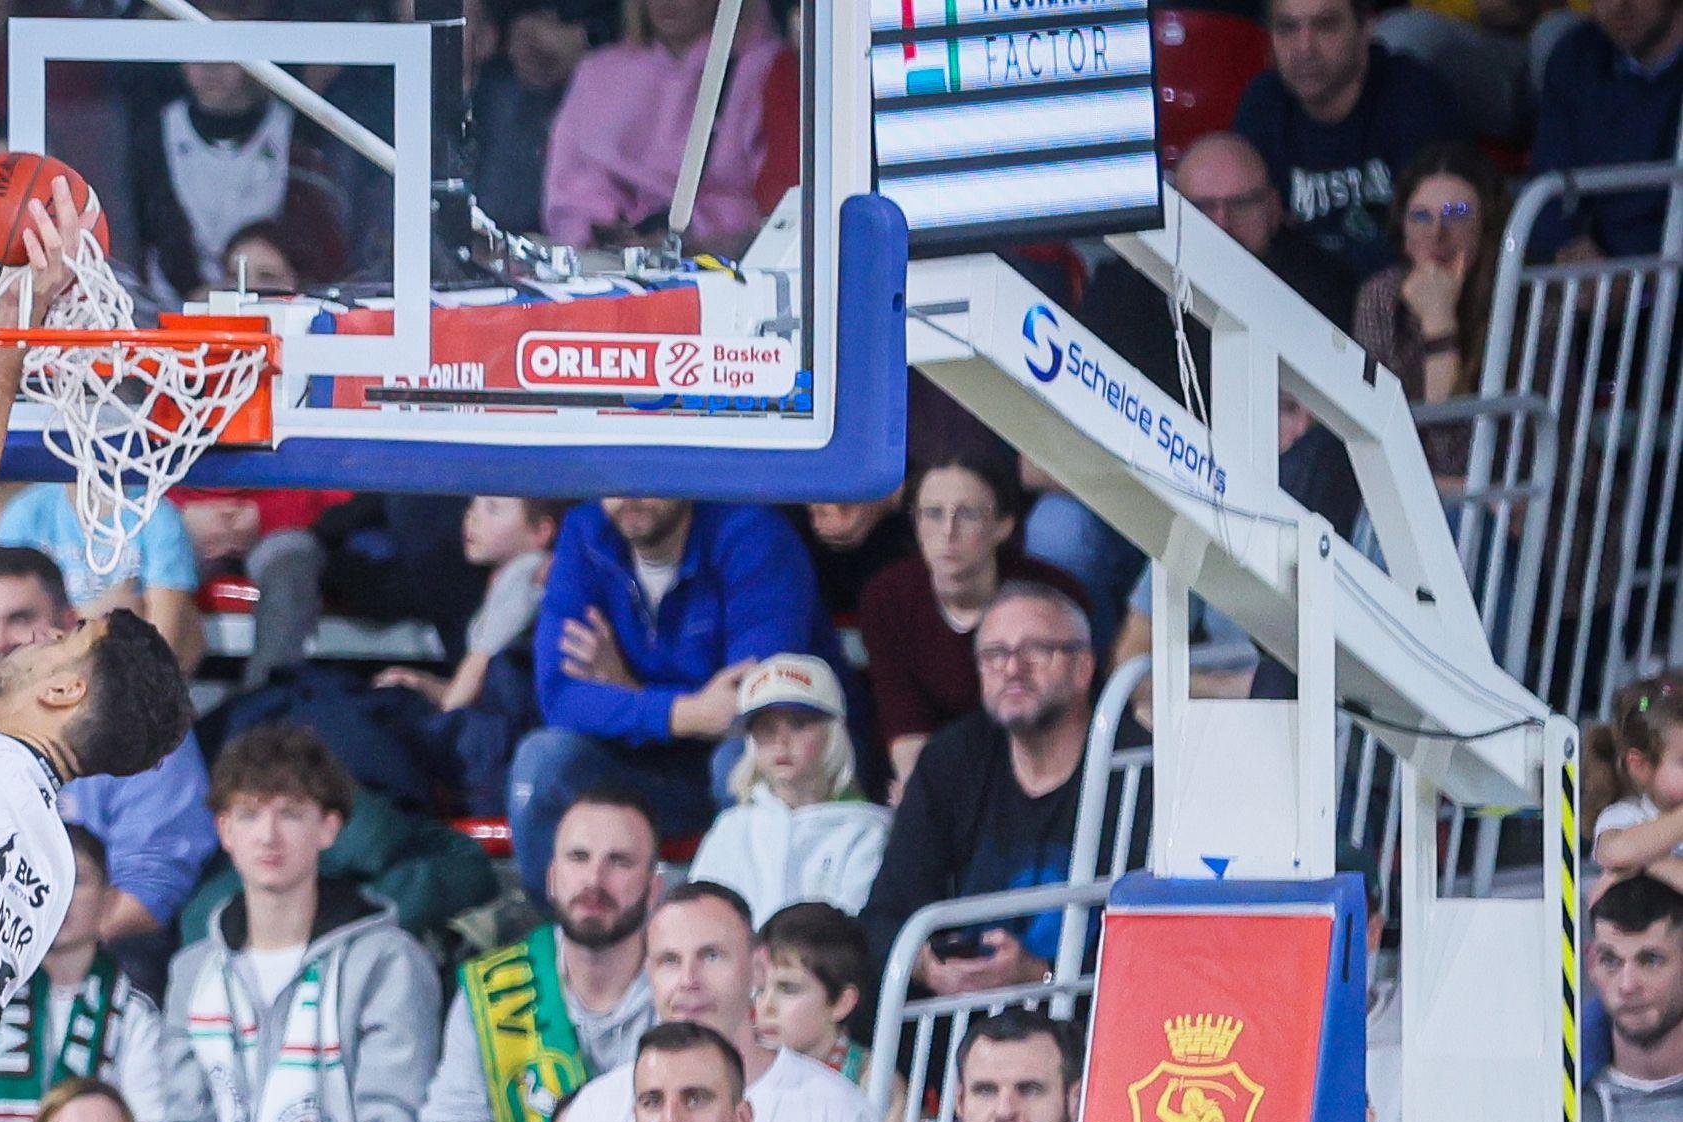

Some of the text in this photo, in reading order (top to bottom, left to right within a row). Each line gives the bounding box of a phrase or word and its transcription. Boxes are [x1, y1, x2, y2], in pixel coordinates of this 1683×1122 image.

[984, 26, 1109, 83] FACTOR
[530, 345, 646, 379] ORLEN
[713, 345, 781, 364] Basket
[428, 362, 485, 389] ORLEN
[713, 365, 754, 388] Liga
[1067, 340, 1227, 495] Schelde Sports
